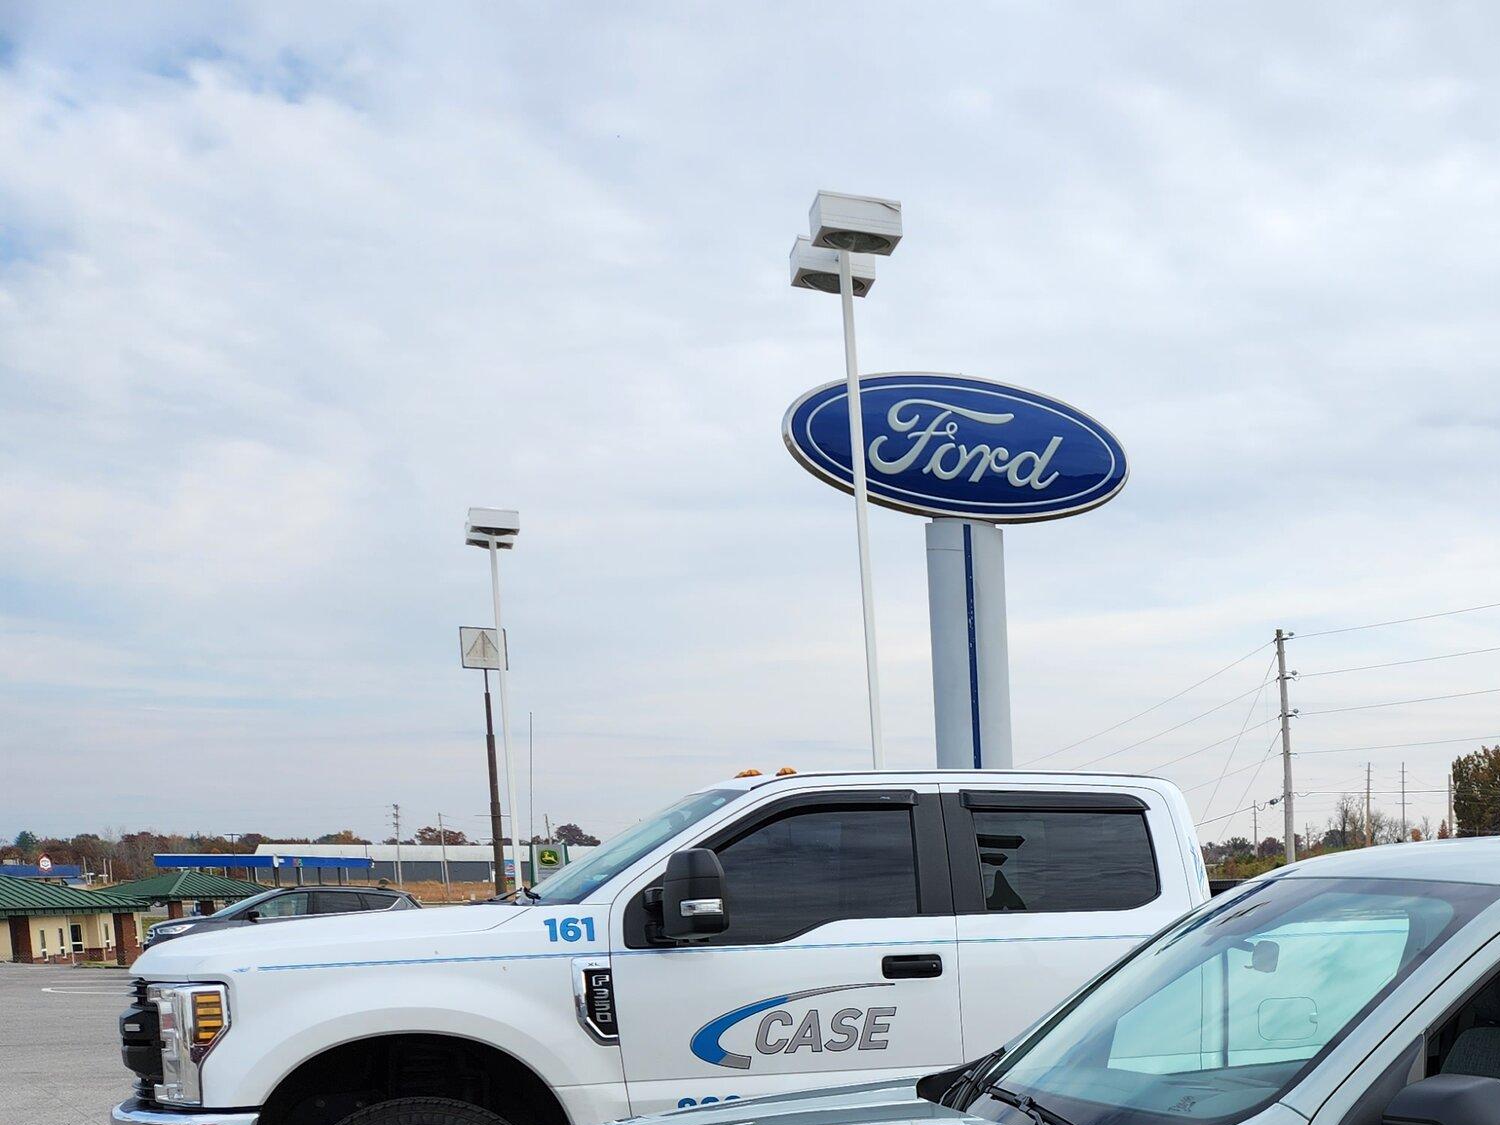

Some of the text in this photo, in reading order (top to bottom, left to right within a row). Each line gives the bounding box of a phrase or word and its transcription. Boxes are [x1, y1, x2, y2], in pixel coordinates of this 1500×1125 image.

[869, 398, 1063, 491] Ford
[544, 917, 595, 942] 161
[755, 1007, 897, 1054] CASE
